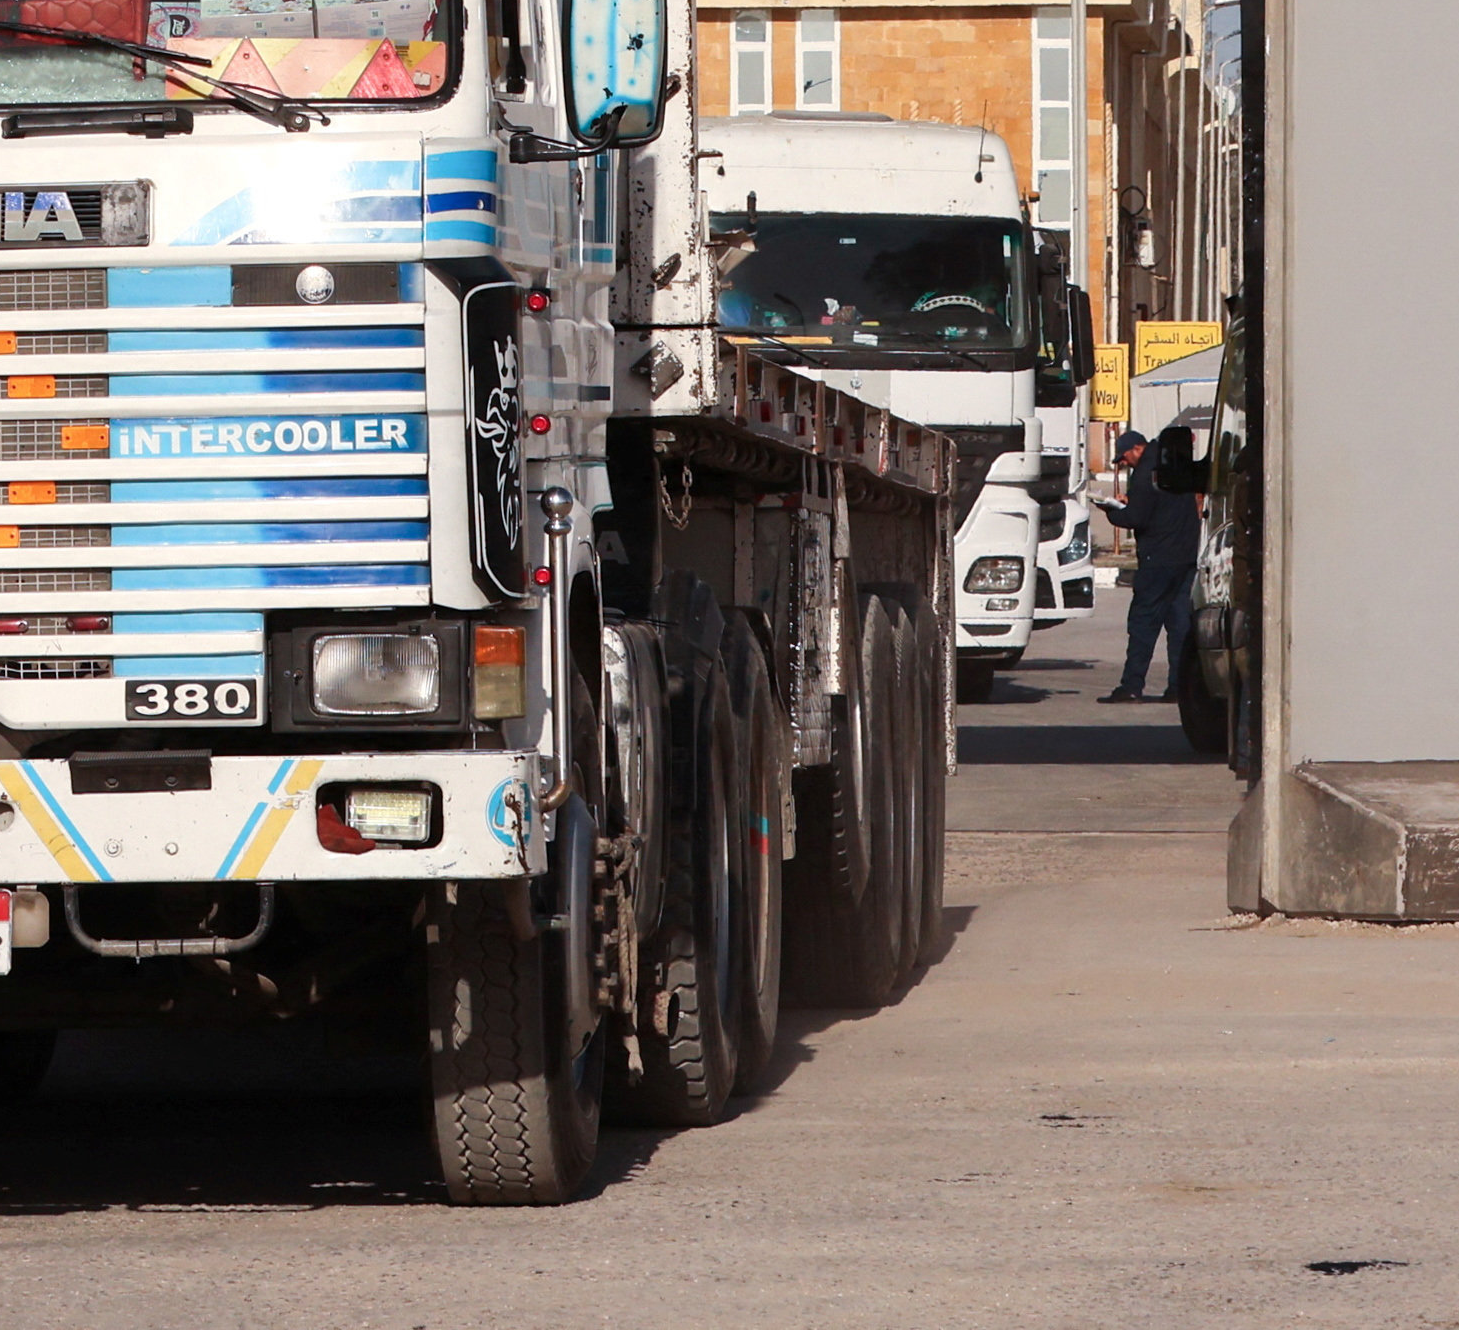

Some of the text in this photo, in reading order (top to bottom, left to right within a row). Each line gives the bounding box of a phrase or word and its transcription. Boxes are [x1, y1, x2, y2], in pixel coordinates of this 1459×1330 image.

[1143, 331, 1180, 349] السفر
[1095, 390, 1118, 409] Way
[132, 678, 253, 719] 380
